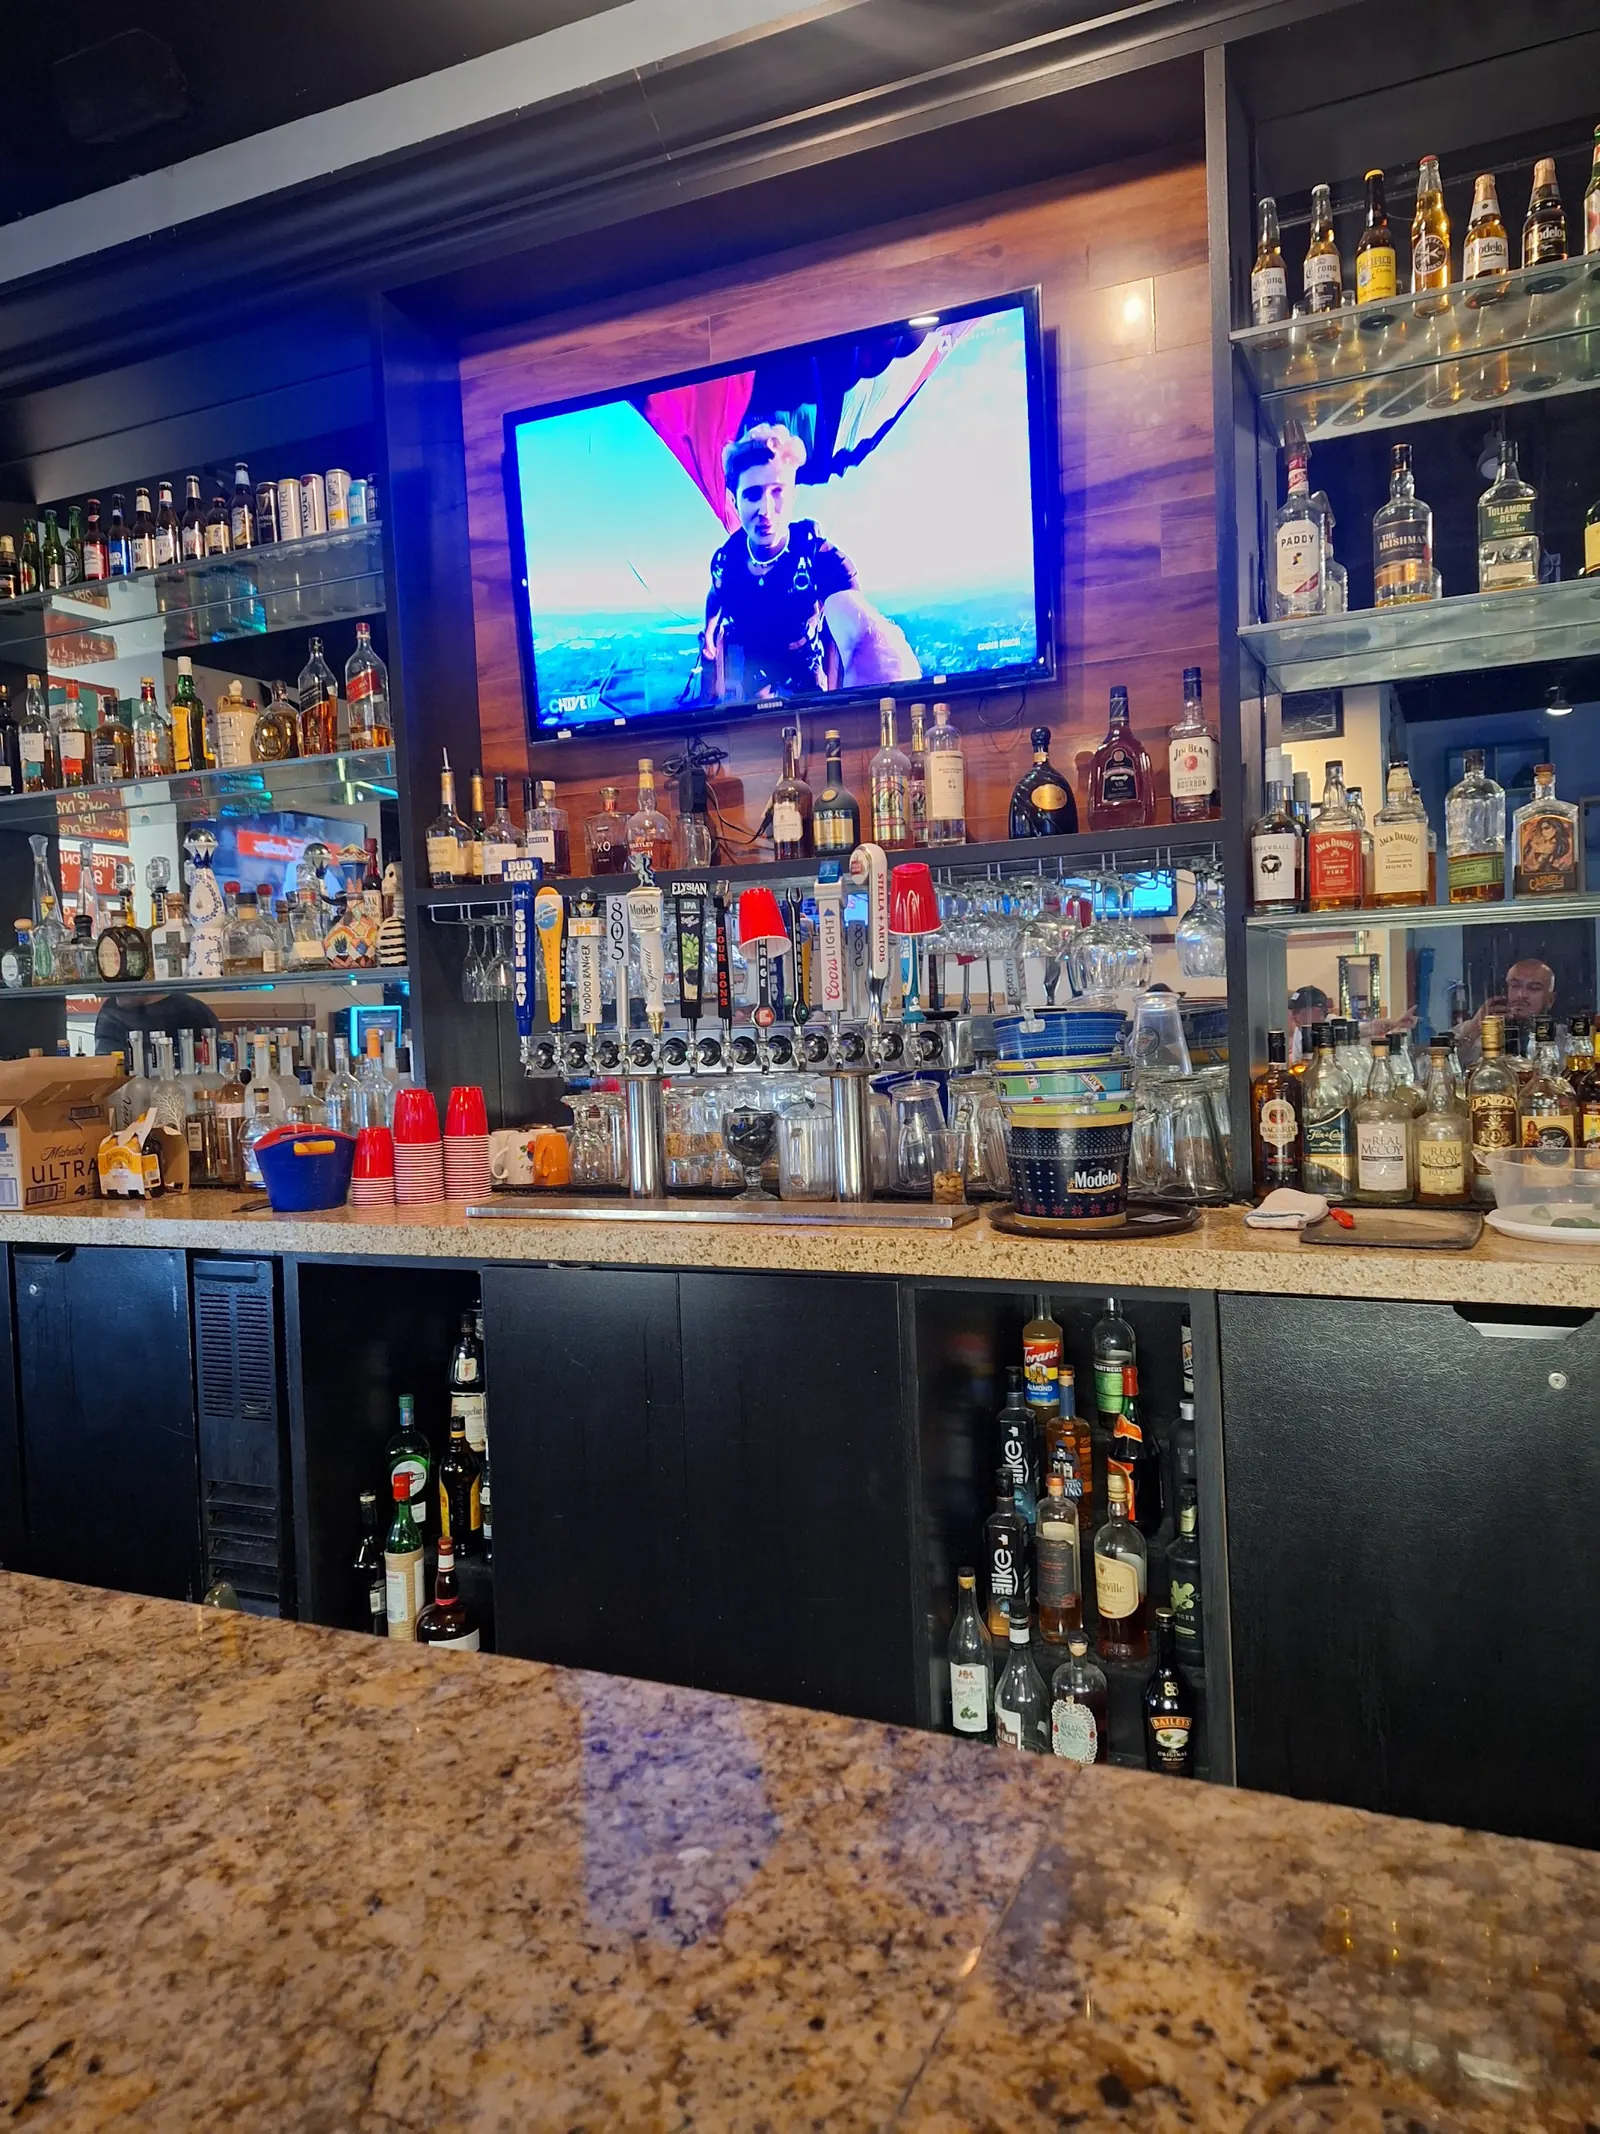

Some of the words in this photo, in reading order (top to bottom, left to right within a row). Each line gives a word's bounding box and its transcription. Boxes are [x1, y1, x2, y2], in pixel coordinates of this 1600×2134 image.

[1487, 503, 1531, 517] TULLAMORE
[1500, 513, 1519, 523] DEW
[1281, 534, 1314, 547] PADDY
[1379, 535, 1427, 551] IRISHMAN
[1382, 532, 1396, 541] THE
[1173, 744, 1187, 761] JIM
[1188, 743, 1209, 757] BEAM
[597, 841, 611, 853] XO
[1316, 840, 1331, 853] JACK
[1379, 834, 1394, 847] JACK
[508, 860, 533, 871] BUD
[503, 869, 538, 882] LIGHT
[672, 882, 708, 896] ELYSIAN
[877, 873, 885, 911] STELLA
[629, 903, 659, 915] Modelo
[683, 901, 697, 910] IPA
[576, 925, 591, 935] IPA
[610, 901, 624, 961] 805
[514, 909, 527, 967] SOUTH
[717, 927, 726, 961] FOUR
[826, 918, 836, 957] LIGHT
[878, 923, 886, 963] ARTOIS
[582, 944, 591, 979] RANGER
[825, 958, 840, 1000] Coors
[515, 971, 527, 1007] BAY
[719, 971, 728, 1006] SONS
[582, 980, 591, 1015] VOODOO
[1372, 1136, 1401, 1146] REAL
[41, 1142, 87, 1162] Michelob
[1361, 1144, 1403, 1155] McCOY
[1431, 1147, 1459, 1156] REAL
[31, 1156, 98, 1184] ULTRA
[1429, 1169, 1454, 1177] RUM
[1074, 1170, 1118, 1188] Modelo
[1023, 1344, 1059, 1364] Torani
[1027, 1383, 1053, 1392] ALMOND
[991, 1548, 1013, 1583] like
[992, 1583, 1013, 1595] me
[1152, 1717, 1191, 1727] BAILEYS
